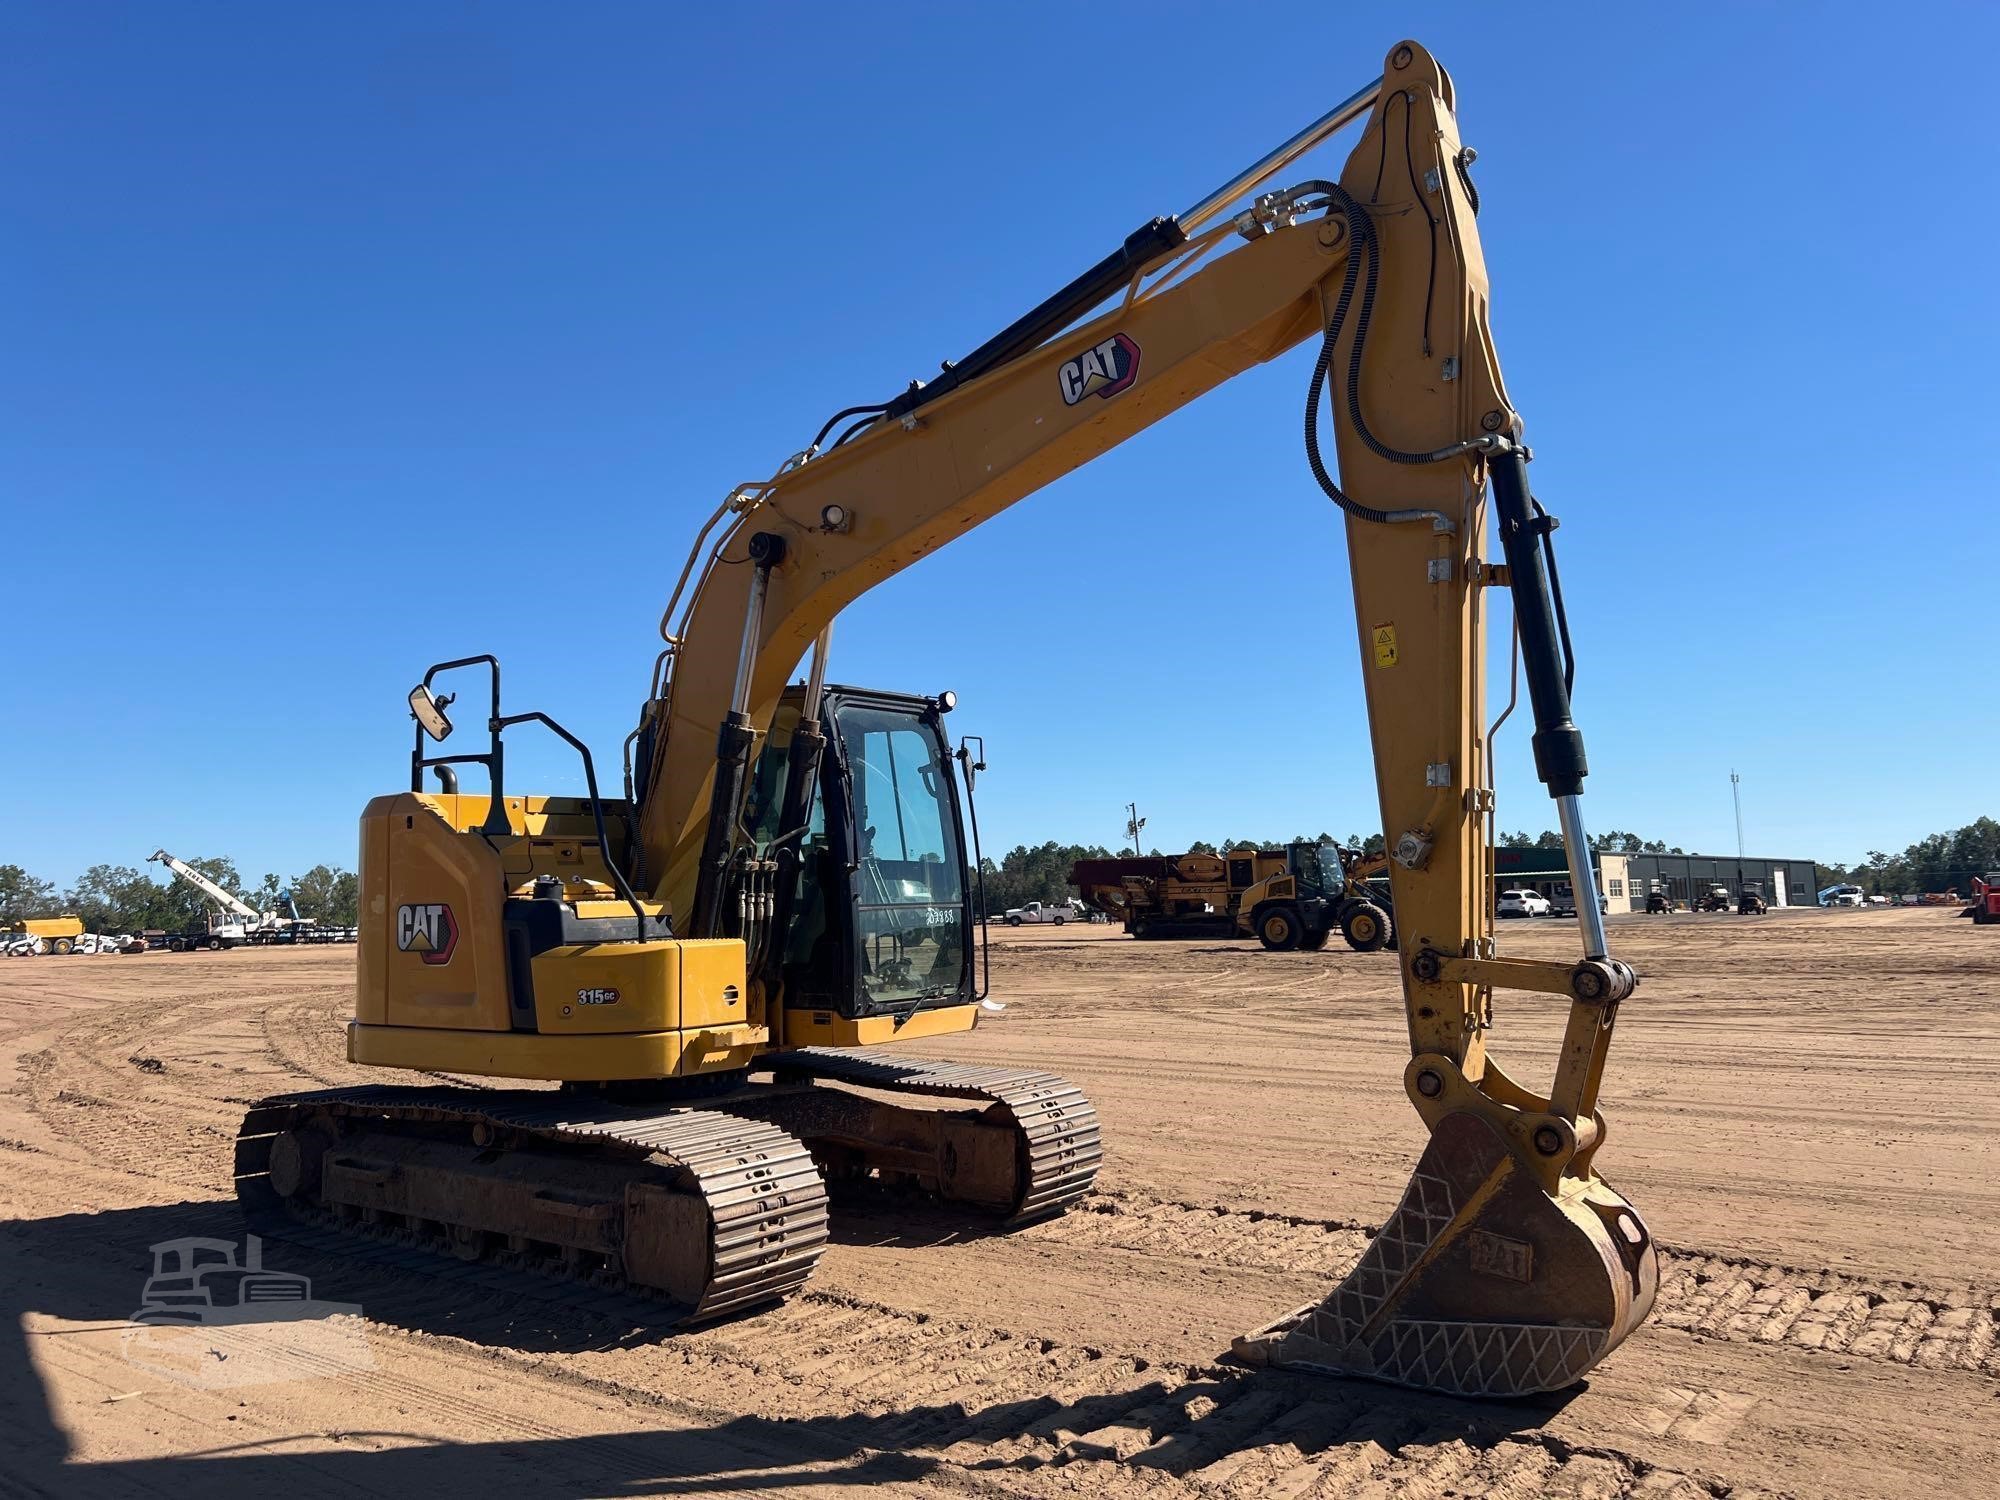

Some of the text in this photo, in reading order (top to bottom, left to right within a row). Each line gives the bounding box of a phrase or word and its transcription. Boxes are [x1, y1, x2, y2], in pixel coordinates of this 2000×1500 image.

[1059, 337, 1119, 404] CAT
[184, 868, 204, 885] TEREX
[397, 905, 443, 950] CAT
